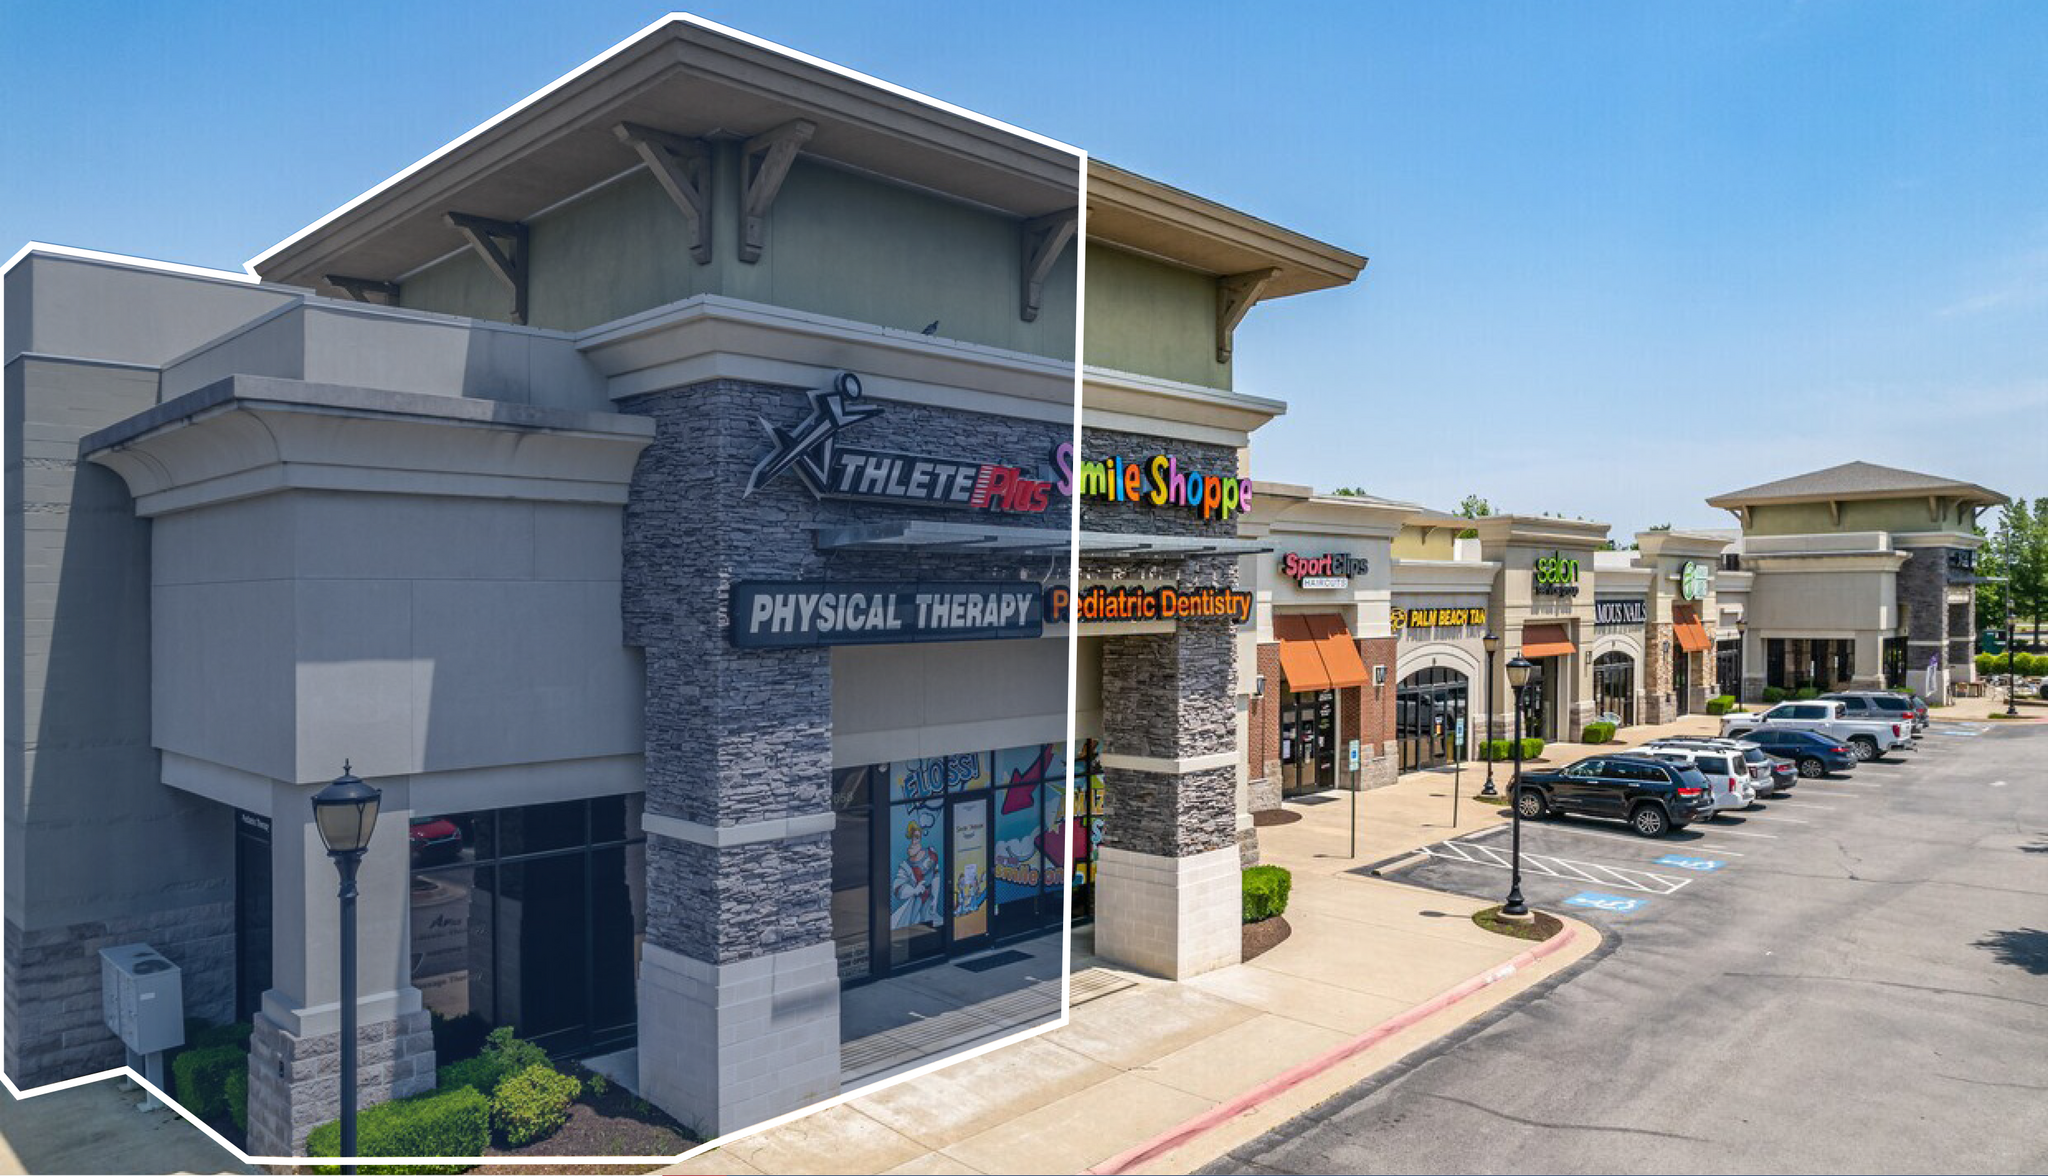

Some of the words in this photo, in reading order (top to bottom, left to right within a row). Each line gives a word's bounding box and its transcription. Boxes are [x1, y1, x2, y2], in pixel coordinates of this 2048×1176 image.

[1056, 442, 1140, 502] Smile
[1150, 454, 1253, 520] Shoppe
[1537, 549, 1580, 584] salon
[749, 592, 903, 634] PHYSICAL
[916, 593, 1033, 629] THERAPY
[1162, 590, 1251, 621] Dentistry
[1411, 609, 1438, 627] PALM
[1439, 609, 1468, 626] BEACH
[1623, 602, 1648, 622] NAILS
